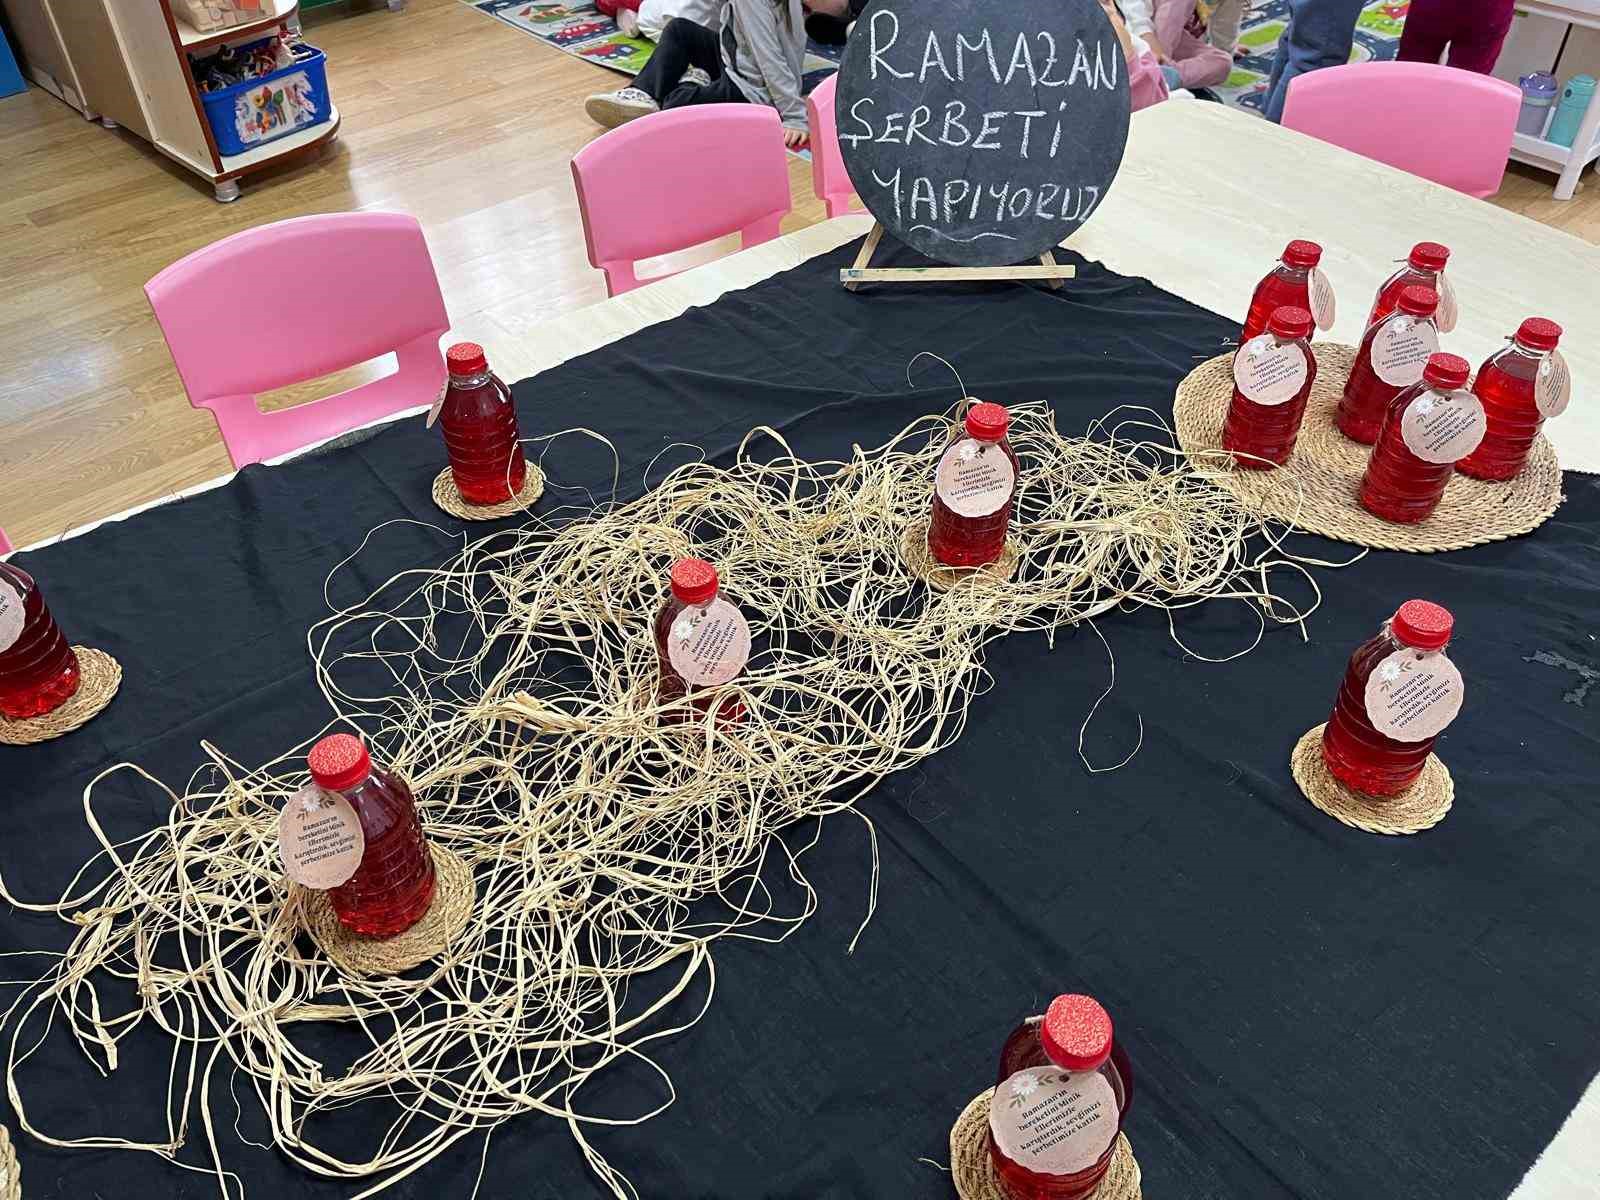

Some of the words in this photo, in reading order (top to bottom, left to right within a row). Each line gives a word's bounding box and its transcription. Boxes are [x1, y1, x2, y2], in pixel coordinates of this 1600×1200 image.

[868, 9, 1118, 91] RAMAZAN
[838, 97, 1068, 159] ŞERBETİ
[871, 167, 1101, 224] YAPIYORUZ
[1416, 673, 1435, 688] Minik
[1018, 1105, 1059, 1132] bereketini
[1059, 1092, 1082, 1108] Minik
[1034, 1106, 1077, 1133] Ellerimizle
[1066, 1101, 1101, 1126] sevgimizi
